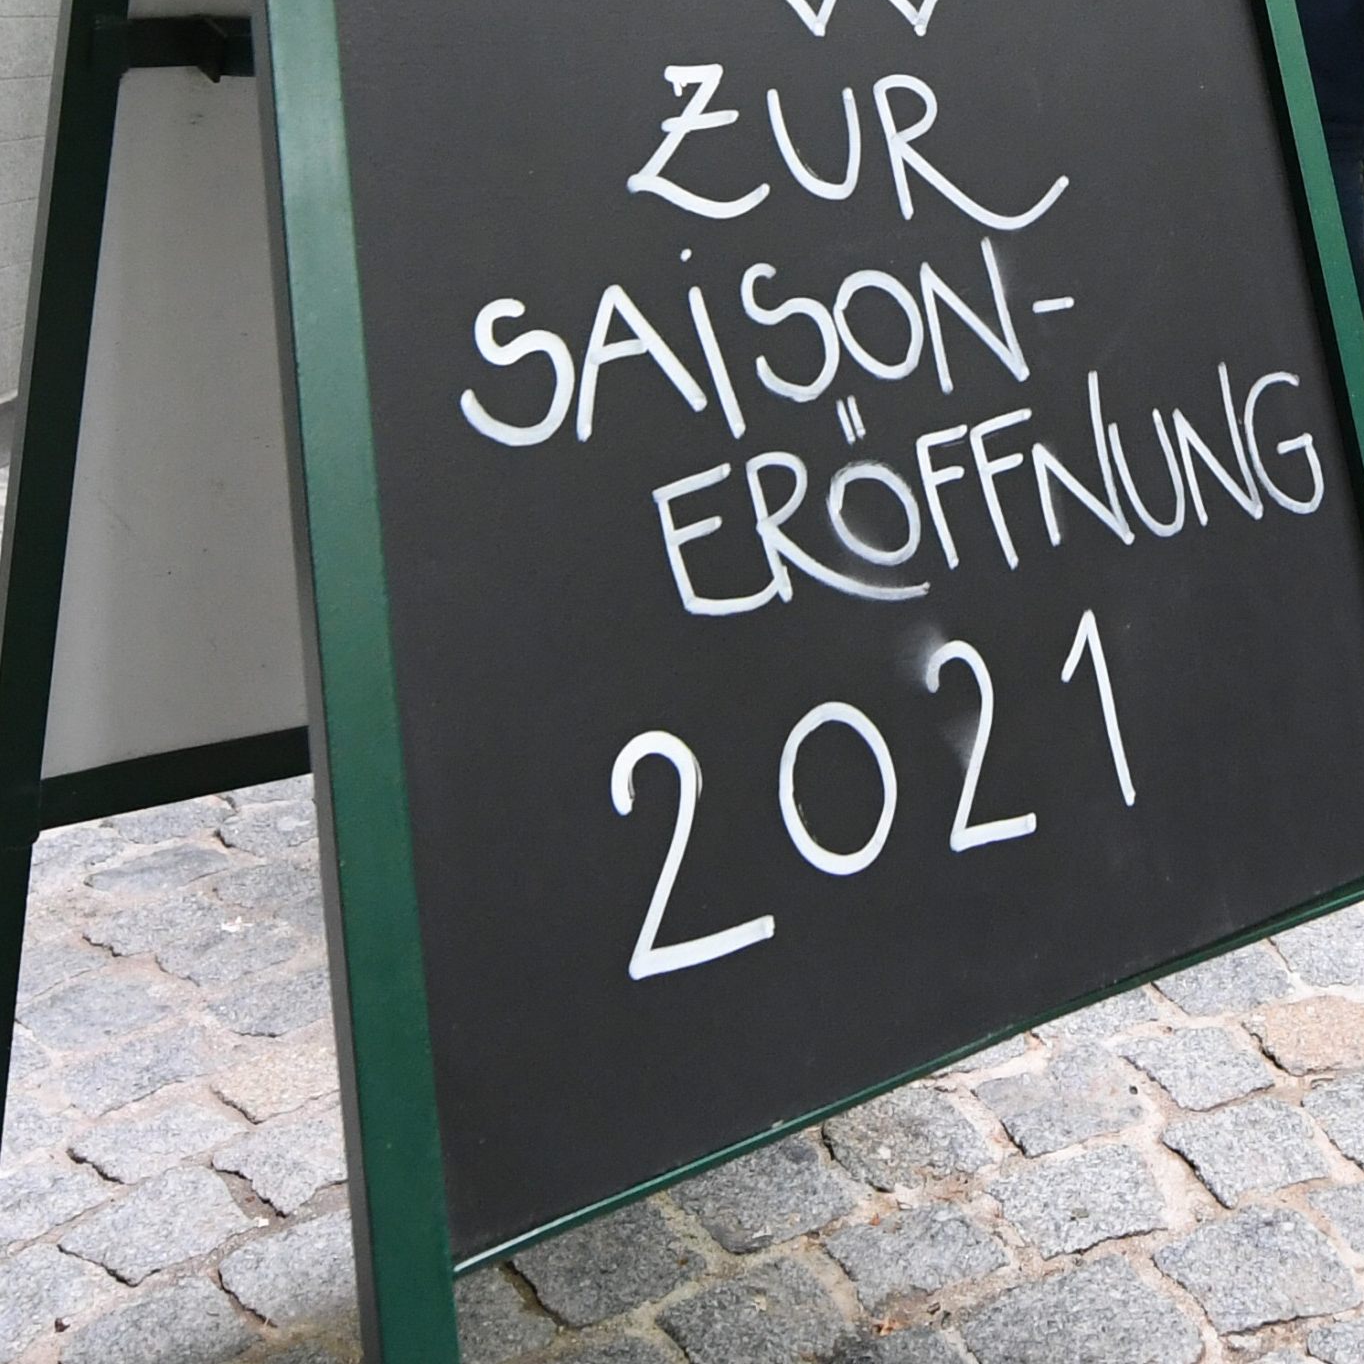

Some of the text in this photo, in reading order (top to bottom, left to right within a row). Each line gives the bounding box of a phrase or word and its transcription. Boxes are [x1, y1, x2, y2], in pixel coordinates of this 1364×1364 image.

[627, 64, 1069, 230] ZUR
[652, 362, 1324, 616] ERÖFFNUNG
[611, 610, 1137, 980] 2021
